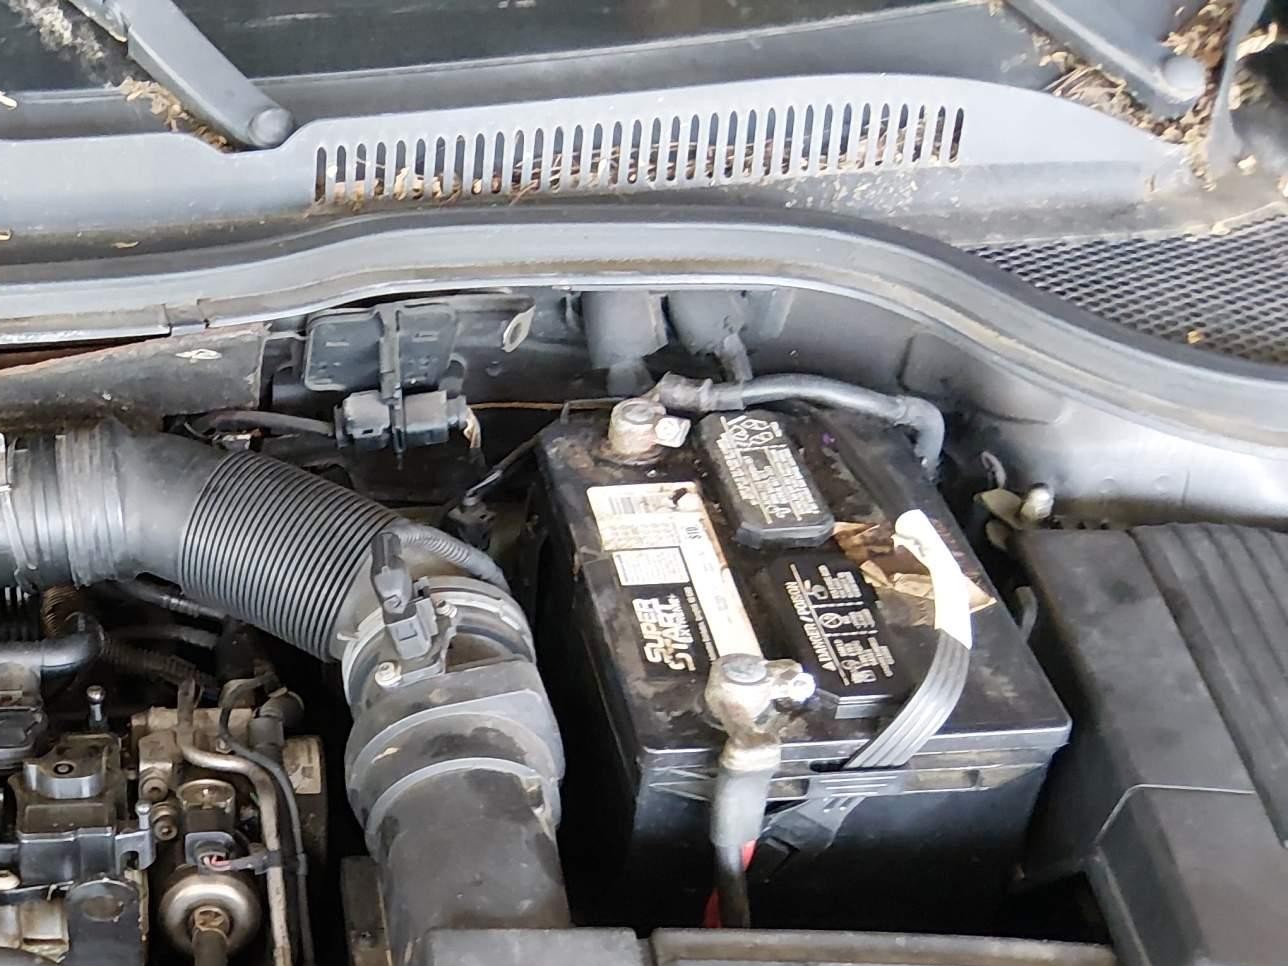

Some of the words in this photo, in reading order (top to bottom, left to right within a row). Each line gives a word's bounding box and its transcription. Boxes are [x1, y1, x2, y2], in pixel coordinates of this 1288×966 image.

[632, 598, 663, 663] SUPER
[784, 581, 812, 616] POISON
[657, 602, 697, 672] START
